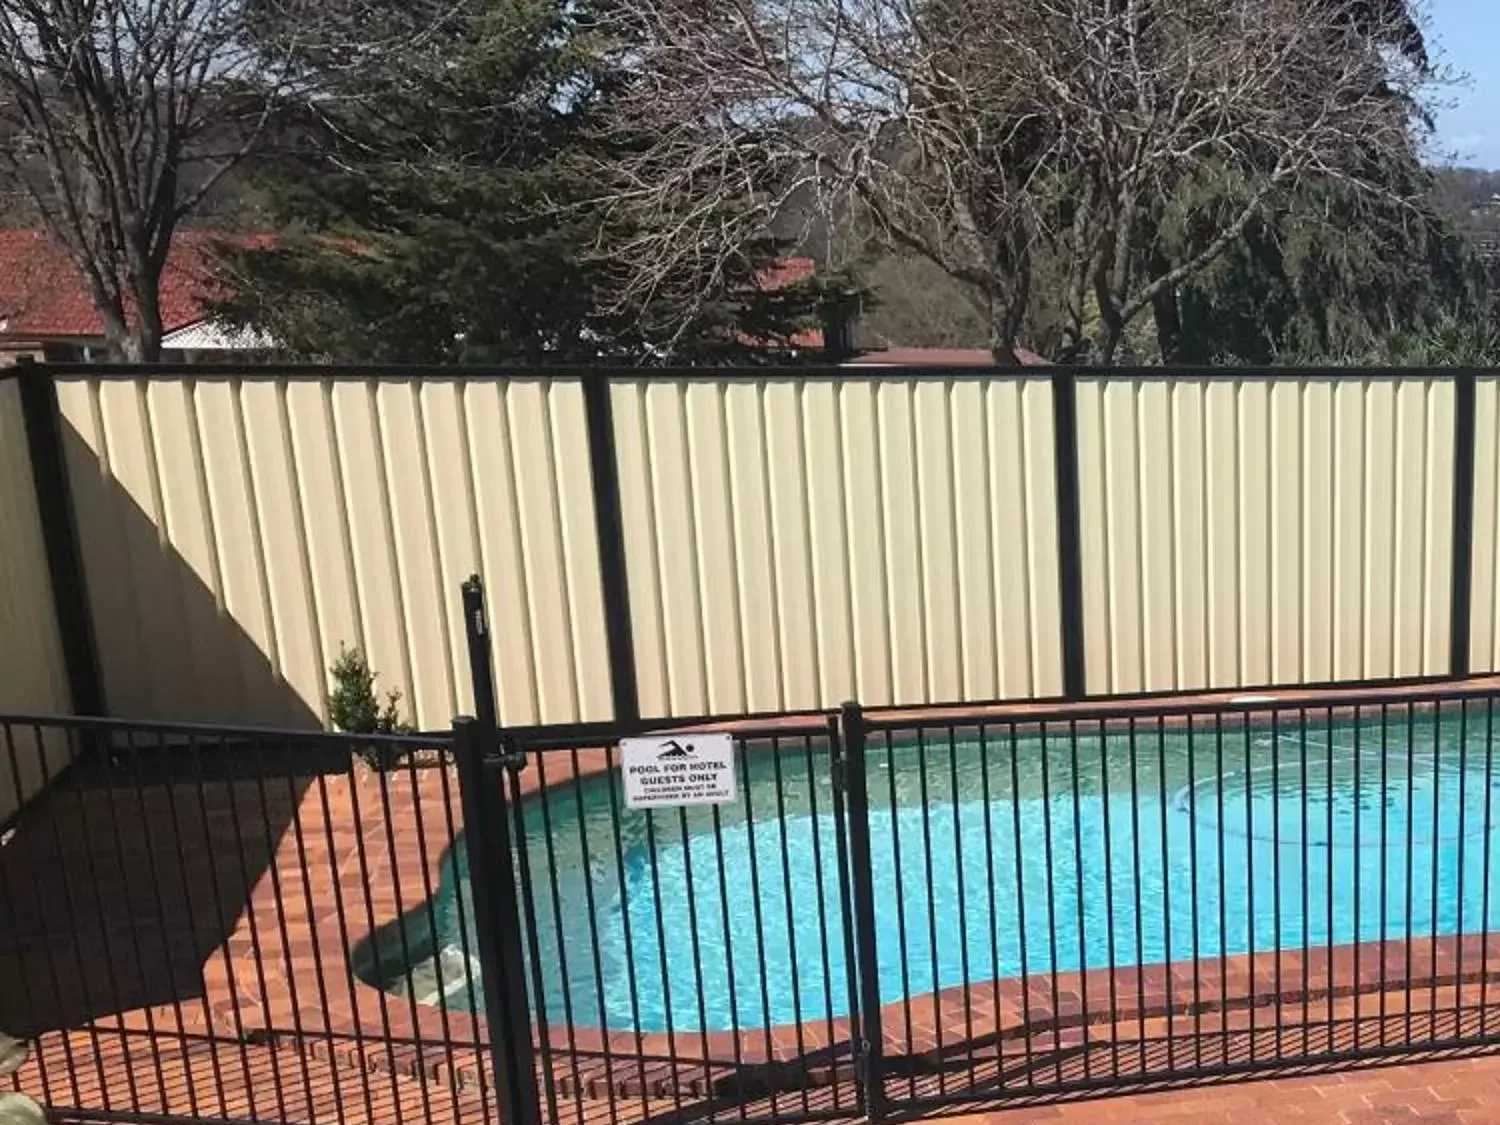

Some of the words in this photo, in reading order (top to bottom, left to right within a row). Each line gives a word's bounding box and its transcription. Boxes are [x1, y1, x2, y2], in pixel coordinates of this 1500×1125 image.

[629, 764, 661, 775] POOL
[664, 763, 687, 773] FOR
[640, 774, 685, 786] GUESTS
[688, 773, 718, 783] ONLY
